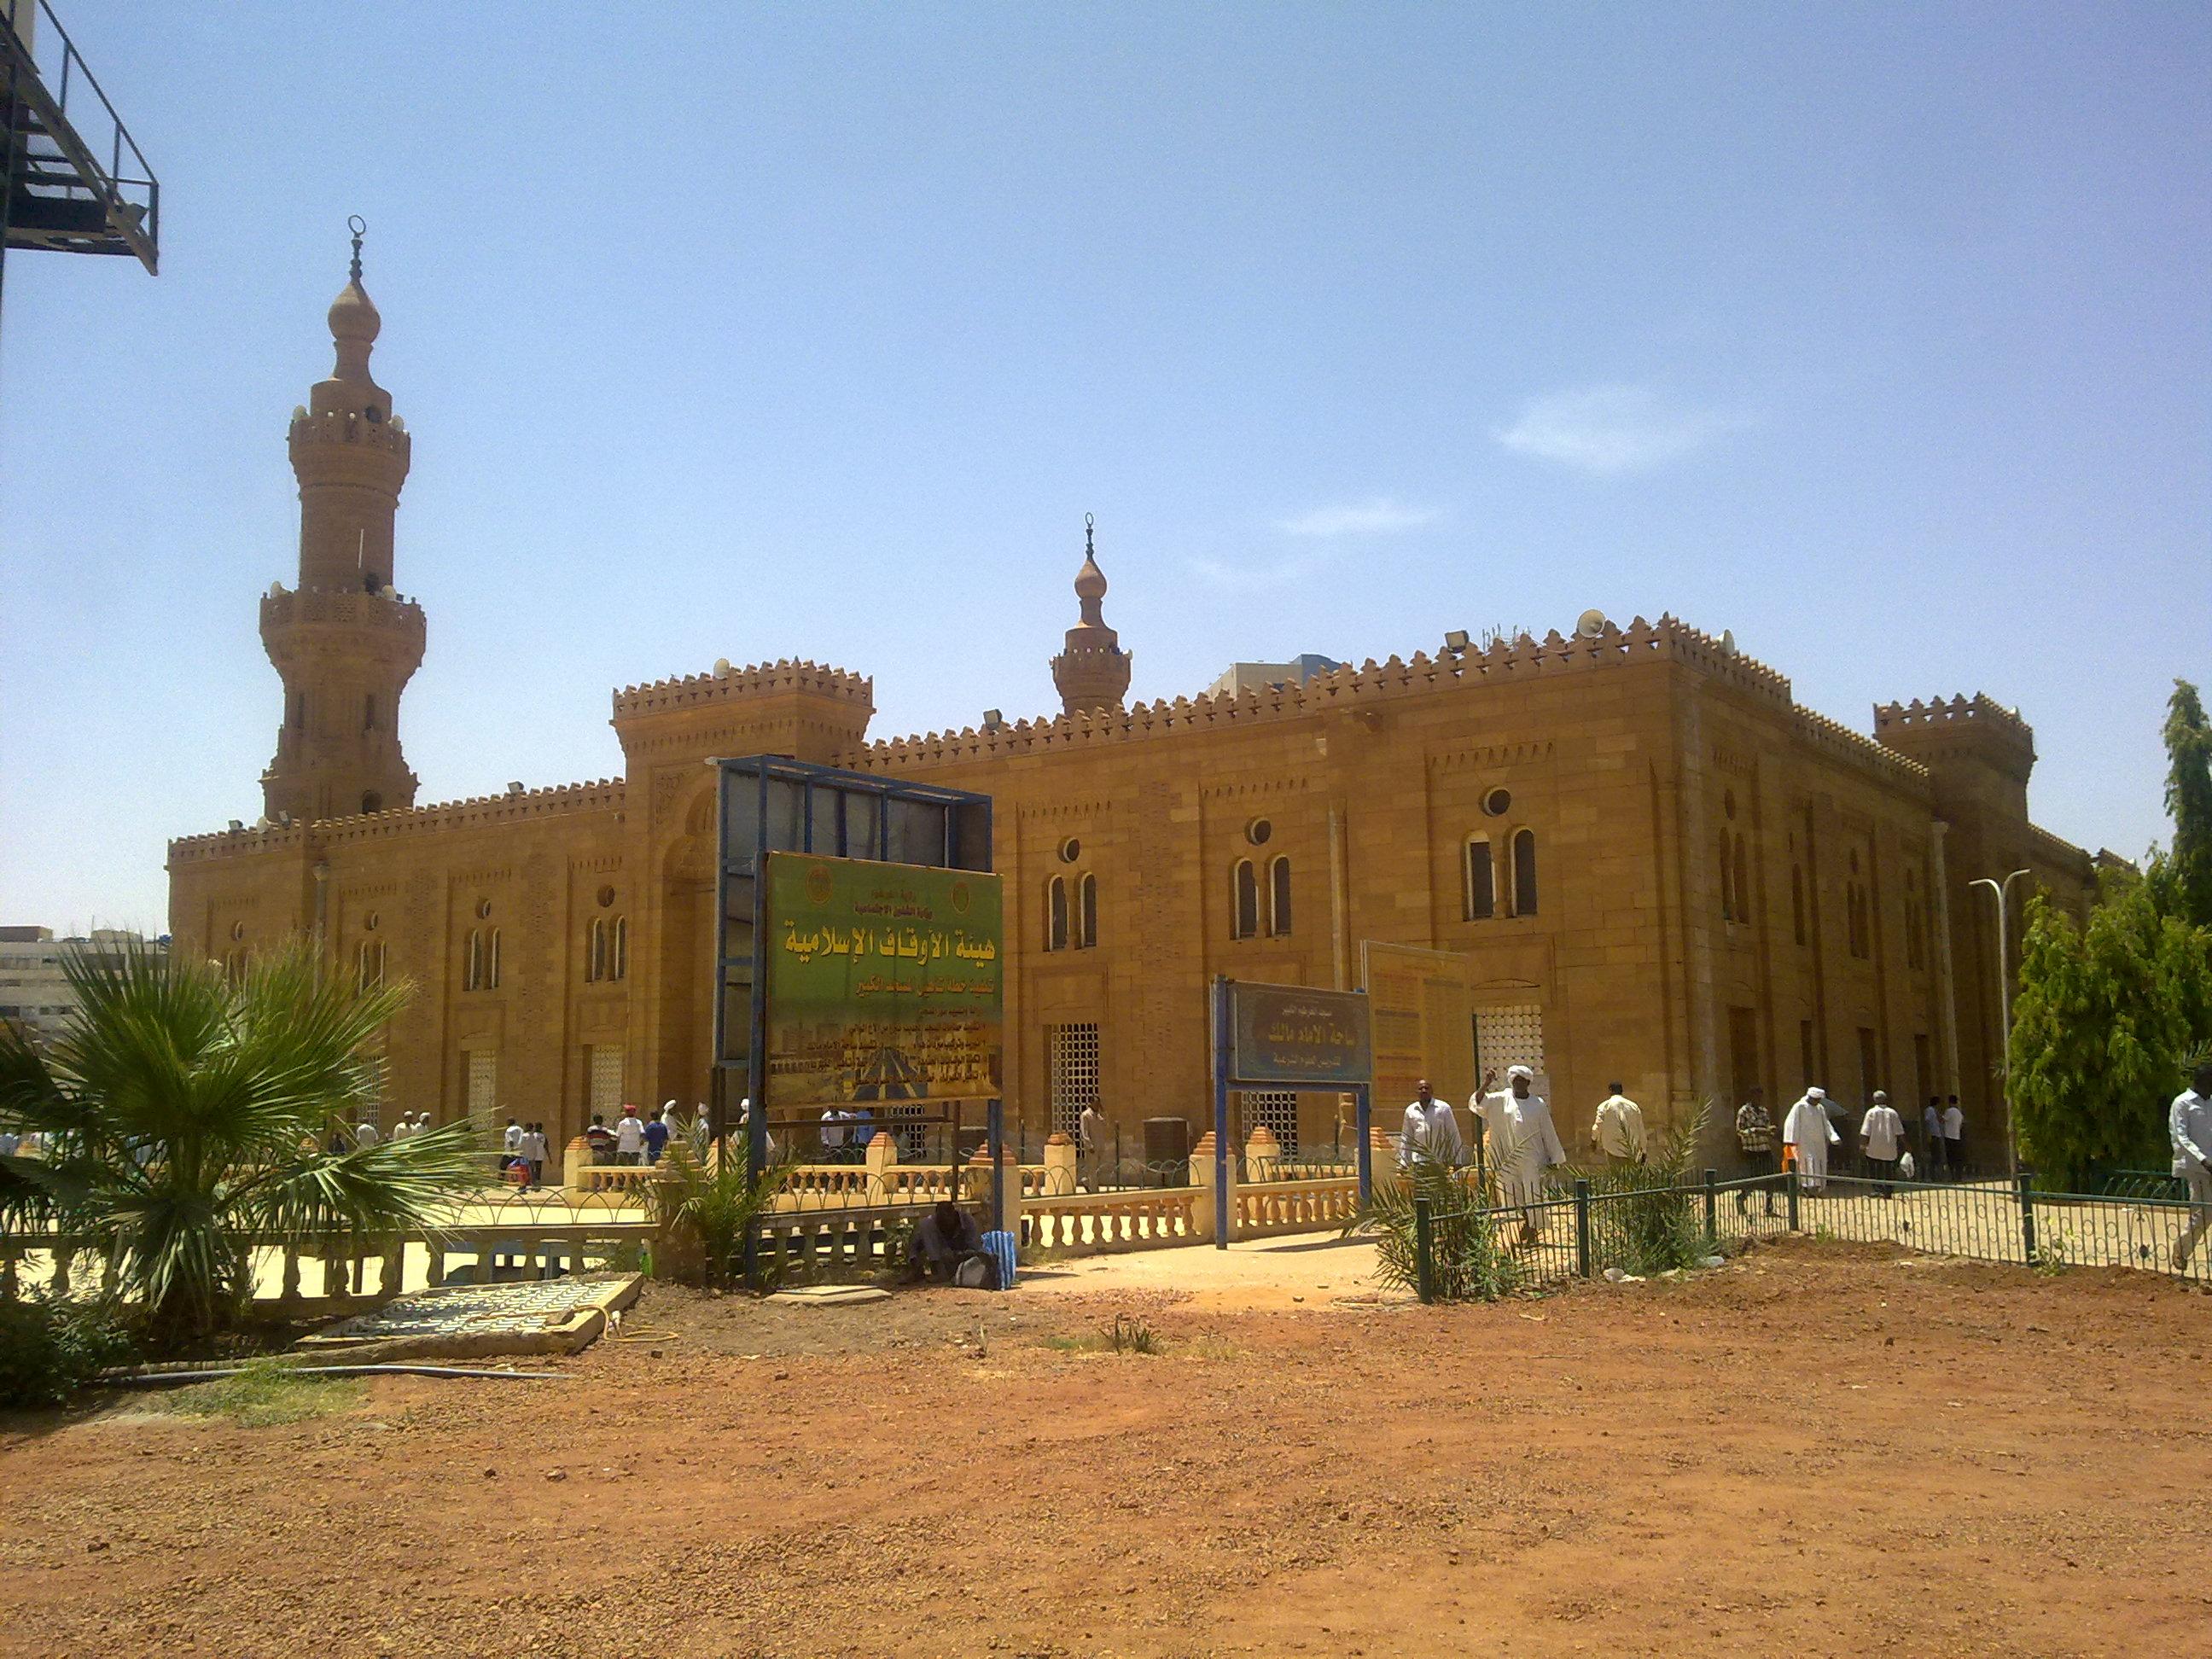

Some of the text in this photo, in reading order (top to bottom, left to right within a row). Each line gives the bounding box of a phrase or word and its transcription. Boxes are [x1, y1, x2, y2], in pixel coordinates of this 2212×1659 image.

[783, 919, 997, 968] هيئة الأوقاف الإسلامية
